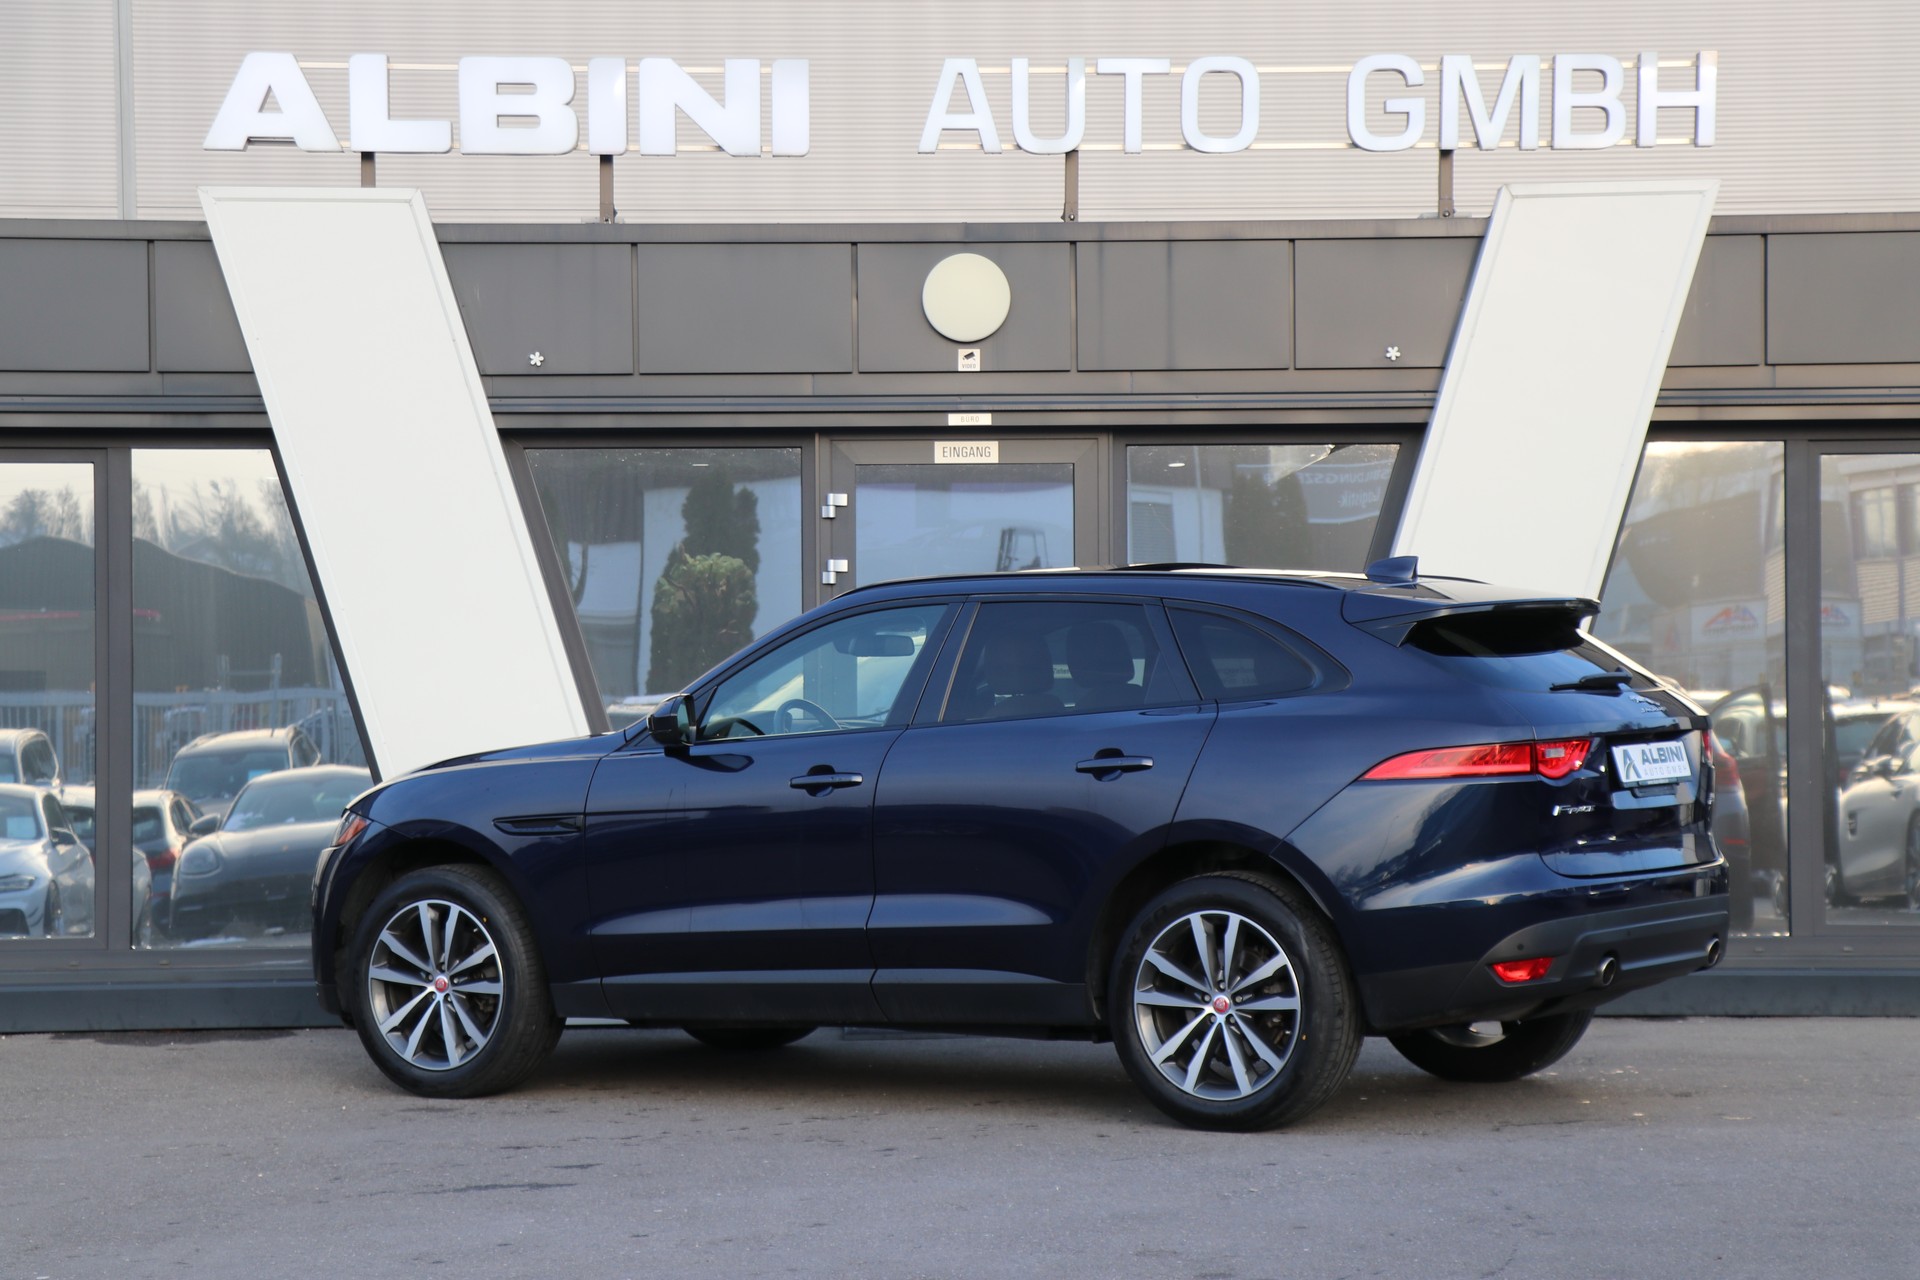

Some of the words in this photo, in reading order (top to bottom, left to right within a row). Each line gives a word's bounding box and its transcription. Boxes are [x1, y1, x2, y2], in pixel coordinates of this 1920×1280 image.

[203, 51, 810, 157] ALBINI
[917, 55, 1260, 155] AUTO
[1346, 50, 1719, 153] GMBH
[960, 415, 980, 423] BÜRO
[942, 446, 991, 458] EINGANG
[1641, 745, 1685, 765] ALBINI
[1644, 766, 1665, 777] AUTO
